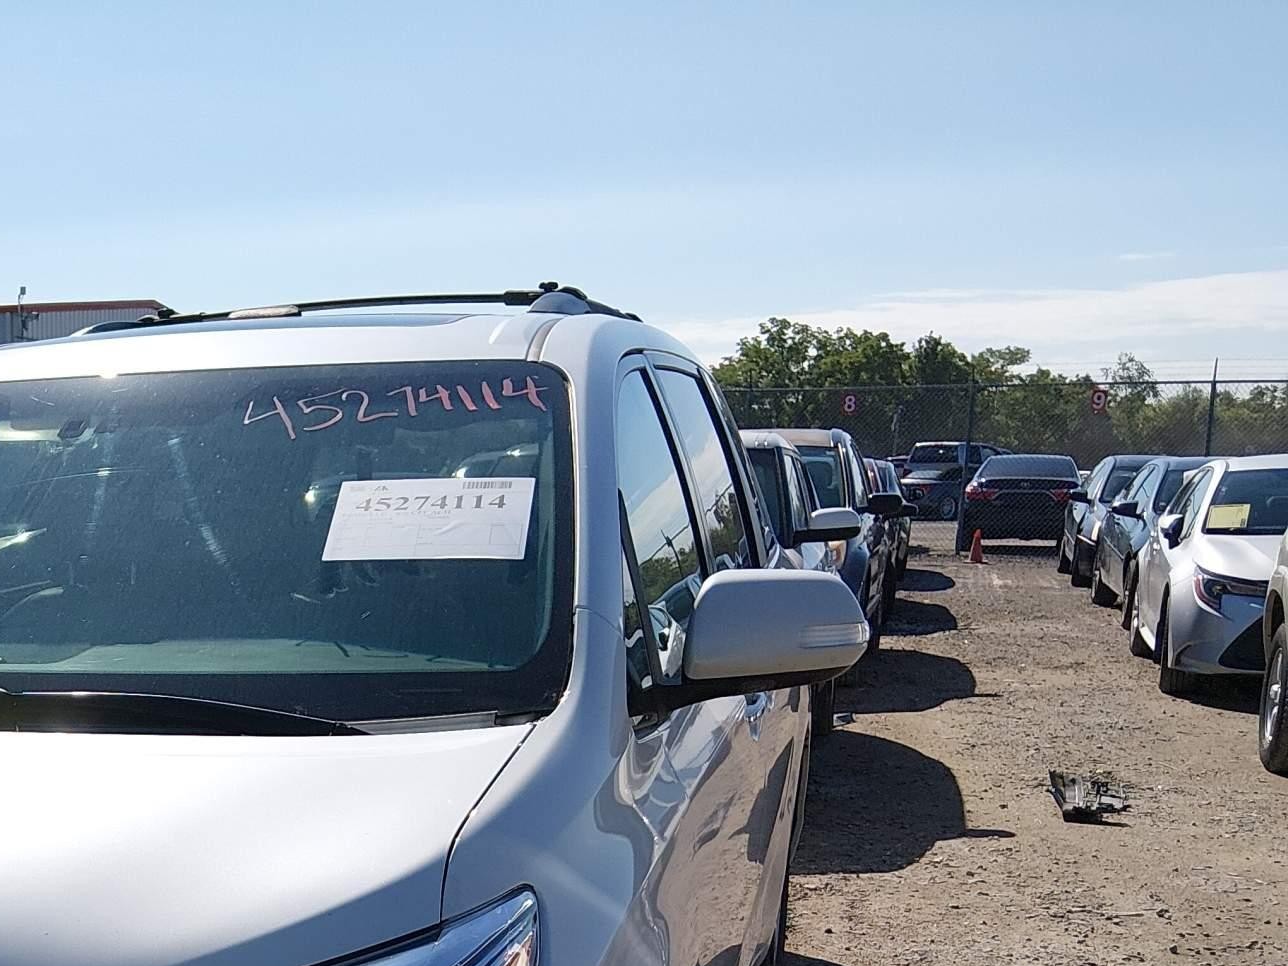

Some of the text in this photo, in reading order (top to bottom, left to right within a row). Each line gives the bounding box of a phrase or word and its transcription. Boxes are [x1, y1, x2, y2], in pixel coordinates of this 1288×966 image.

[243, 375, 549, 440] 45274114
[844, 395, 856, 412] 8
[1092, 391, 1106, 410] 9
[355, 494, 507, 512] 45274114
